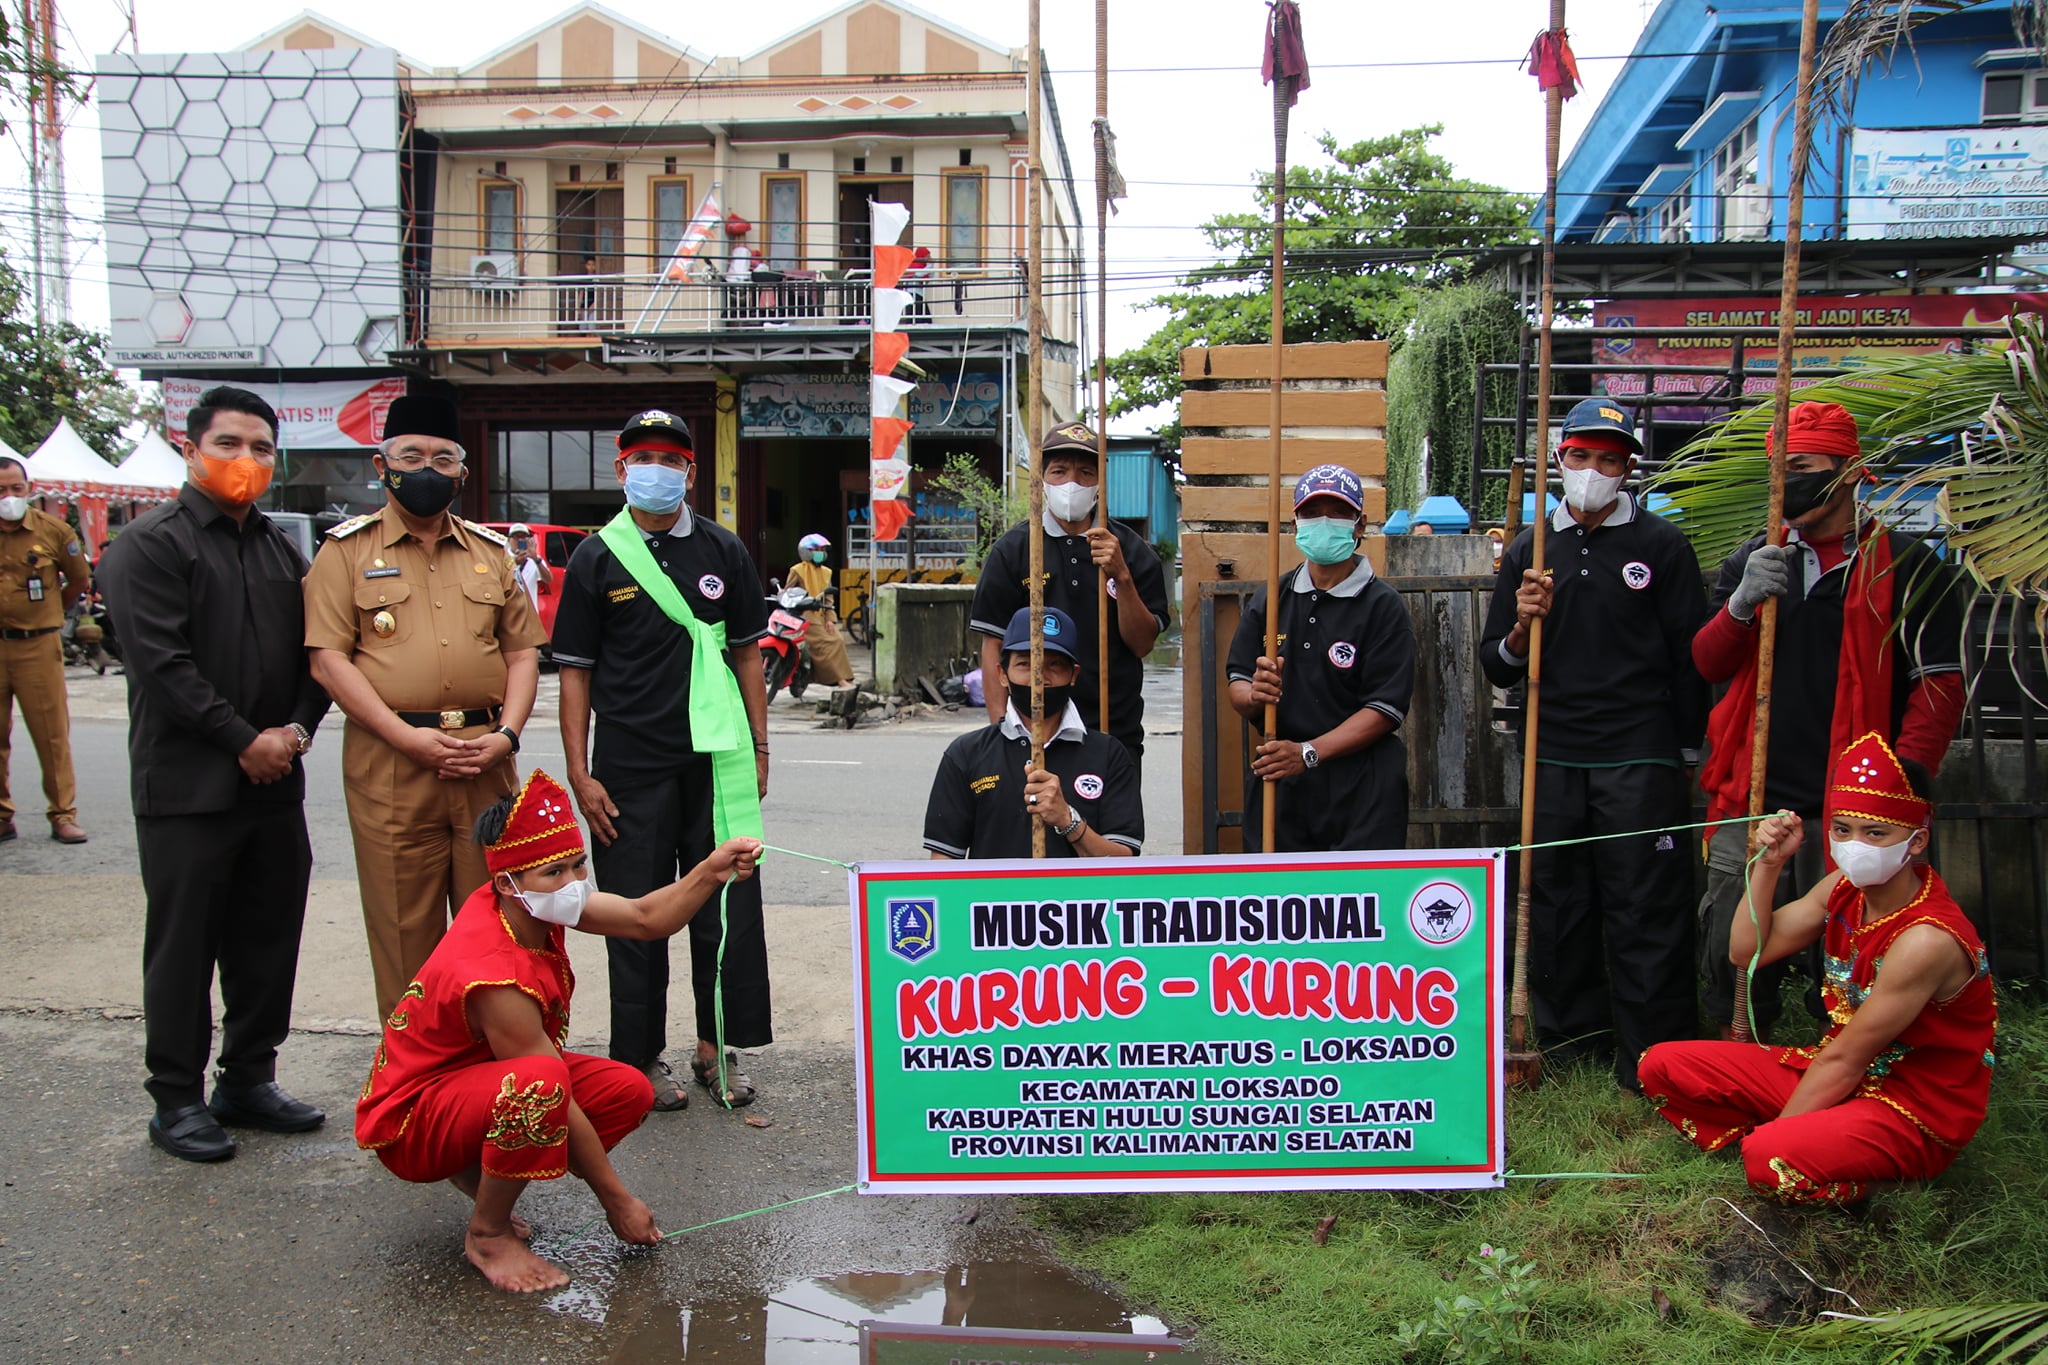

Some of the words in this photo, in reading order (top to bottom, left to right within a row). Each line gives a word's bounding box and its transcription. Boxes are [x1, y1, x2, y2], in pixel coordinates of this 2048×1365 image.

[1885, 177, 1960, 196] Dukung
[1963, 177, 2000, 194] dan
[1900, 203, 1961, 218] PORPROV
[1962, 203, 1978, 217] XI
[1981, 203, 2002, 216] dan
[1885, 222, 1968, 239] KALIMANTAN
[1970, 220, 2029, 237] SELATAN
[1686, 310, 1766, 327] SELAMAT
[1770, 309, 1812, 326] HRI
[1816, 308, 1856, 326] JADI
[1861, 307, 1911, 325] KE-71
[1657, 337, 1733, 348] PROVINS
[116, 351, 165, 361] TELKOMSEL
[166, 350, 217, 361] AUTHORIZED
[217, 350, 254, 360] PARTNER
[165, 382, 201, 394] Posko
[808, 374, 870, 384] RUMAH
[749, 383, 858, 404] PUTRA
[911, 382, 999, 402] NANG
[275, 407, 314, 422] ATIS
[318, 407, 334, 422] !!!
[814, 403, 869, 414] MASAKA
[915, 558, 955, 570] PADA
[972, 902, 1109, 948] MUSIK
[1115, 896, 1383, 945] TRADISIONAL
[899, 959, 1144, 1040] KURUNG
[1212, 955, 1456, 1026] KURUNG
[903, 1046, 993, 1069] KHAS
[1003, 1044, 1109, 1068] DAYAK
[1119, 1041, 1274, 1067] MERATUS
[1303, 1035, 1455, 1062] LOKSADO
[1021, 1080, 1195, 1101] KECAMATAN
[1204, 1076, 1339, 1099] LOKSADO
[928, 1108, 1096, 1128] KABUPATEN
[1105, 1106, 1182, 1127] HULU
[1191, 1104, 1299, 1126] SUNGAI
[1309, 1100, 1433, 1124] SELATAN
[951, 1135, 1083, 1155] PROVINSI
[1092, 1132, 1277, 1154] KALIMANTAN
[1286, 1129, 1412, 1151] SELATAN
